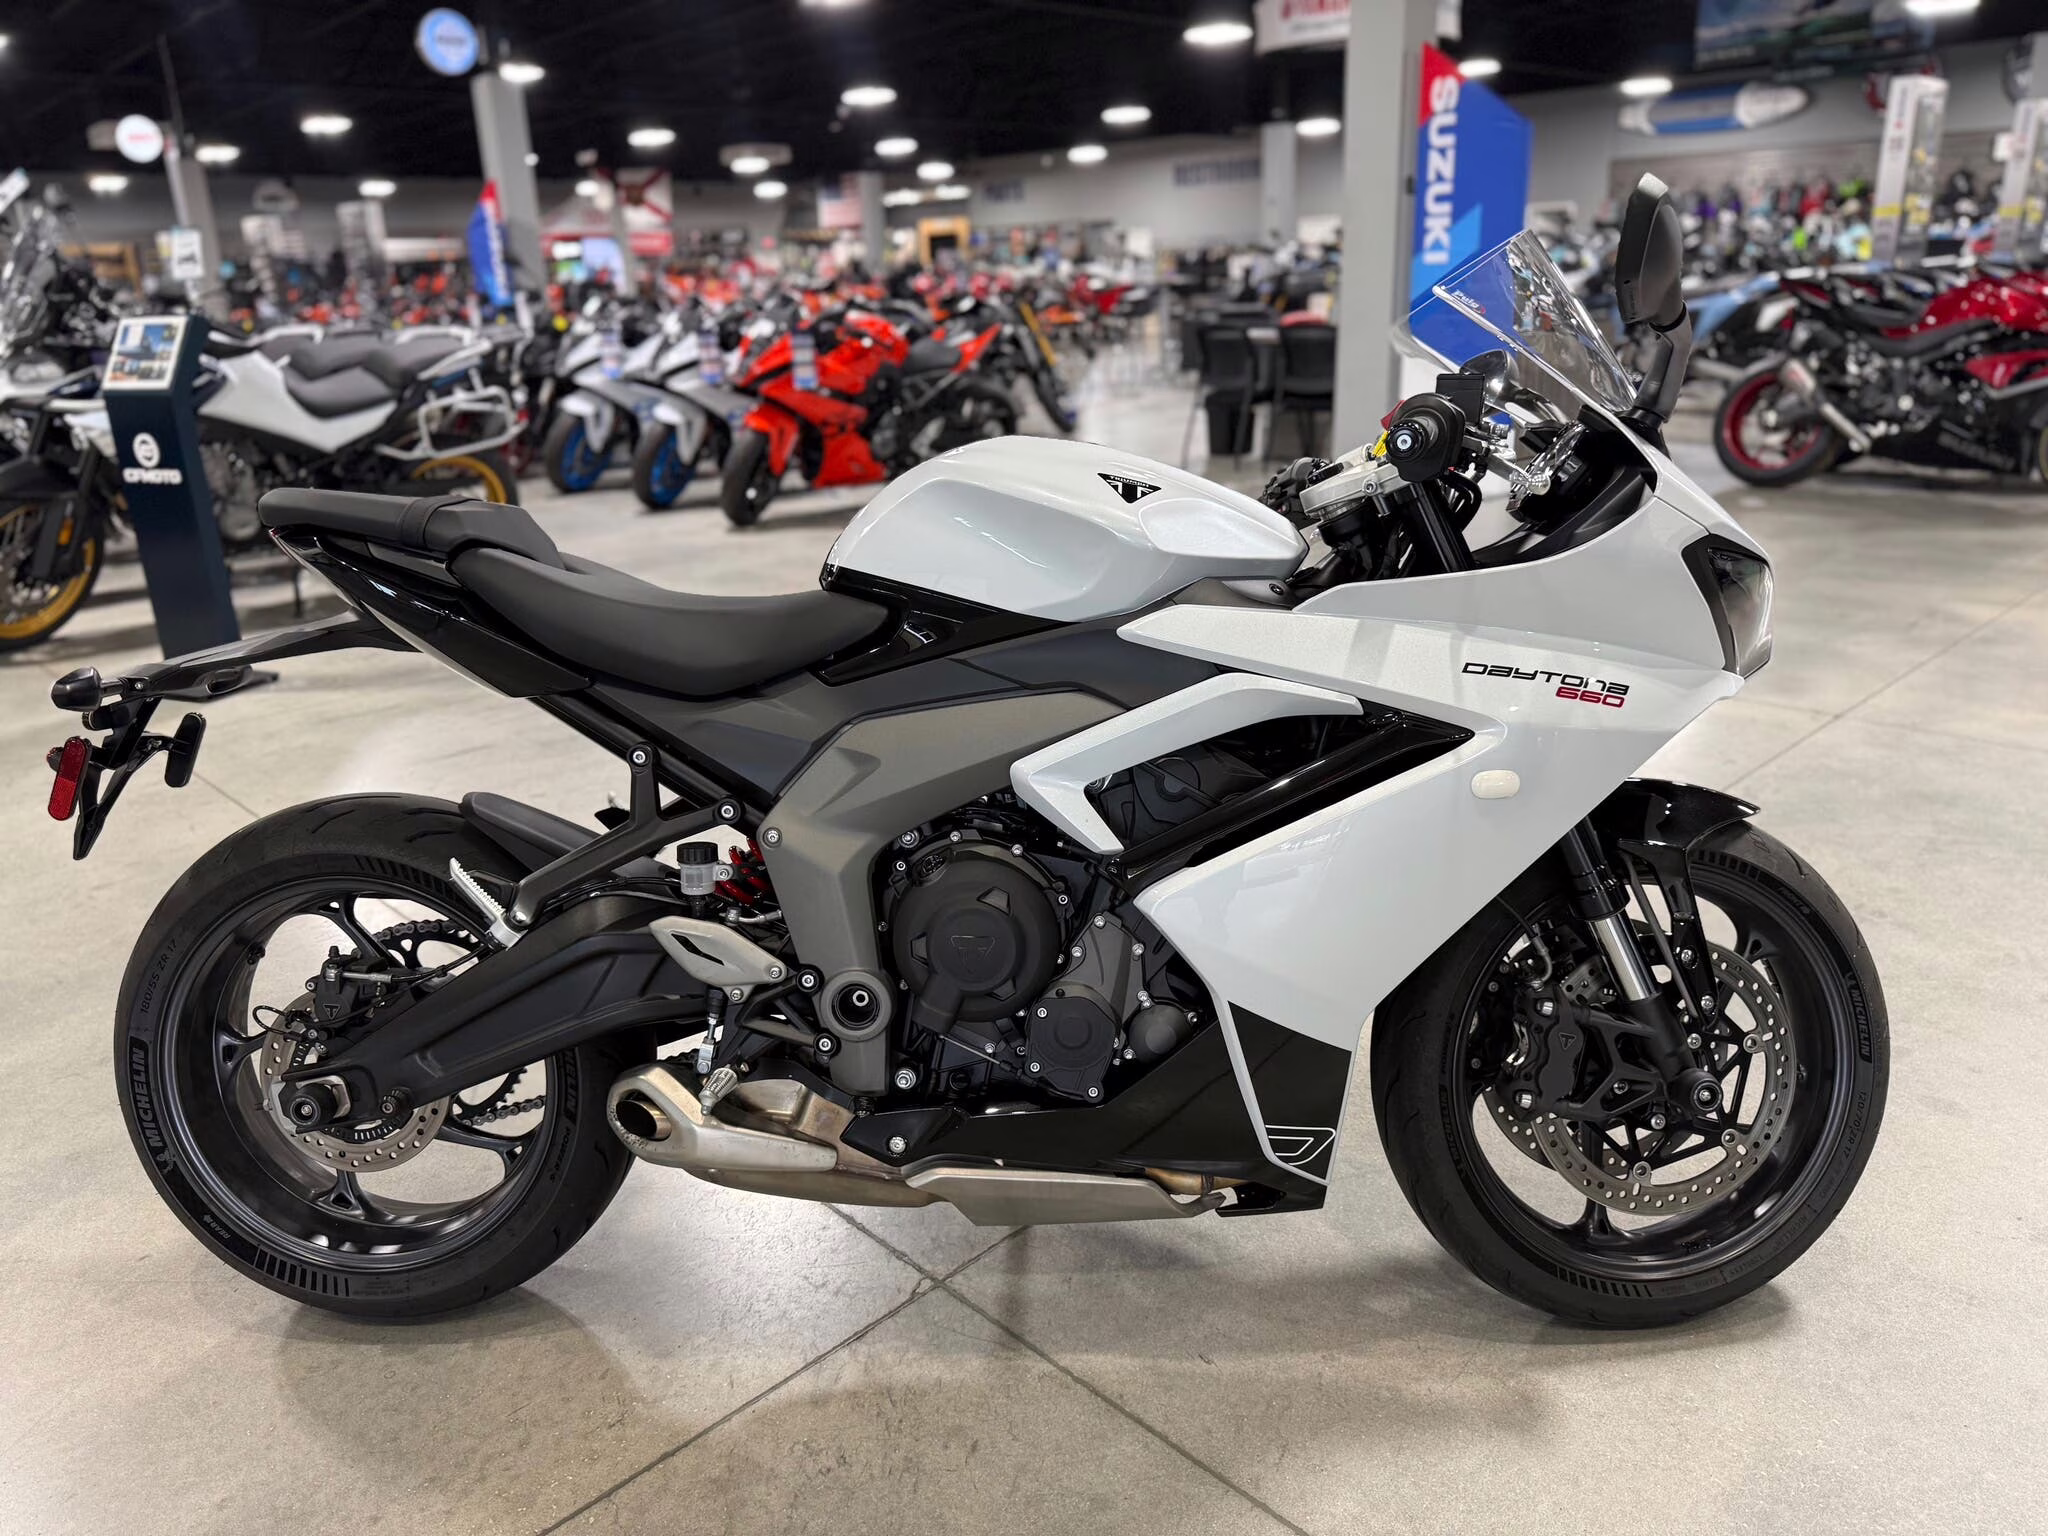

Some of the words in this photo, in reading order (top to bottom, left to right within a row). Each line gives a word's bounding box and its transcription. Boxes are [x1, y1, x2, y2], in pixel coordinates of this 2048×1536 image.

[1422, 74, 1460, 265] SUZUKI
[1555, 686, 1626, 708] 660
[140, 971, 160, 1013] 180/55
[156, 953, 170, 971] ZR
[167, 939, 177, 953] 17
[1850, 989, 1871, 1057] MICHELIN
[132, 1047, 163, 1147] MICHELIN
